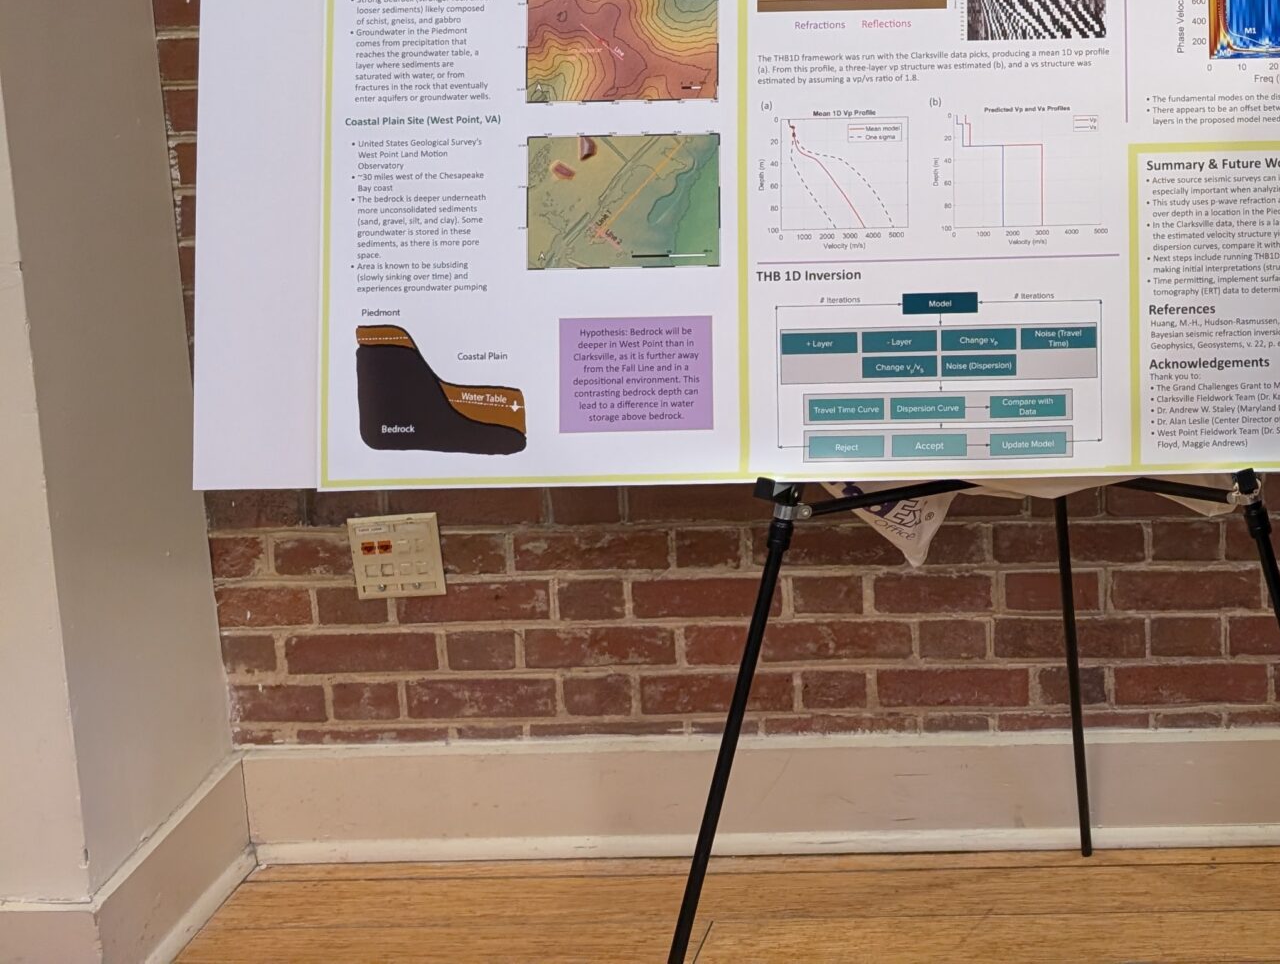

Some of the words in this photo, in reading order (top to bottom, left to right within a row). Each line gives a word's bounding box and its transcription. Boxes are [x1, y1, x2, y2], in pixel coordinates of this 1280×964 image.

[794, 20, 848, 30] Refractions
[861, 18, 912, 29] Reflections
[1191, 17, 1207, 25] 400
[1243, 27, 1256, 35] M1
[1176, 26, 1184, 54] Phase
[1192, 37, 1207, 46] 200
[1237, 63, 1247, 71] 10
[1268, 62, 1279, 71] 20
[1254, 74, 1274, 85] Freq
[345, 116, 380, 126] Coastal
[382, 116, 405, 126] Plain
[407, 116, 425, 125] Site
[426, 116, 454, 126] (West
[456, 115, 483, 125] Point,
[484, 114, 501, 125] VA)
[1146, 160, 1205, 171] Summary
[1208, 158, 1218, 170] &
[1222, 158, 1261, 169] Future
[756, 271, 781, 282] THB
[785, 270, 801, 281] 1D
[805, 269, 861, 281] Inversion
[928, 300, 952, 308] Model
[361, 308, 400, 317] Piedmont
[1149, 304, 1216, 315] References
[579, 326, 628, 338] Hypothesis:
[629, 326, 663, 337] Bedrock
[665, 326, 680, 335] will
[681, 326, 692, 335] be
[1057, 329, 1082, 338] (Travel
[578, 339, 608, 350] deeper
[609, 339, 617, 348] in
[618, 340, 640, 348] West
[642, 340, 663, 348] Point
[665, 339, 684, 347] than
[686, 338, 694, 347] in
[1046, 340, 1071, 350] Time)
[457, 352, 487, 362] Coastal
[488, 351, 508, 361] Plain
[945, 362, 968, 370] Noise
[968, 361, 1012, 371] (Dispersion)
[1149, 357, 1270, 370] Acknowledgements
[1149, 373, 1174, 382] Thank
[1174, 373, 1189, 382] you
[1190, 372, 1202, 380] to:
[459, 392, 484, 403] Water
[486, 394, 507, 404] Table
[1002, 398, 1036, 406] Compare
[813, 406, 836, 414] Travel
[837, 406, 856, 414] Time
[857, 405, 880, 413] Curve
[896, 404, 936, 414] Dispersion
[937, 404, 960, 412] Curve
[1018, 408, 1037, 416] Data
[381, 424, 415, 434] Bedrock
[833, 443, 859, 454] Reject
[914, 442, 944, 452] Accept
[1002, 440, 1030, 450] Update
[1031, 440, 1054, 448] Model
[874, 519, 916, 541] Office
